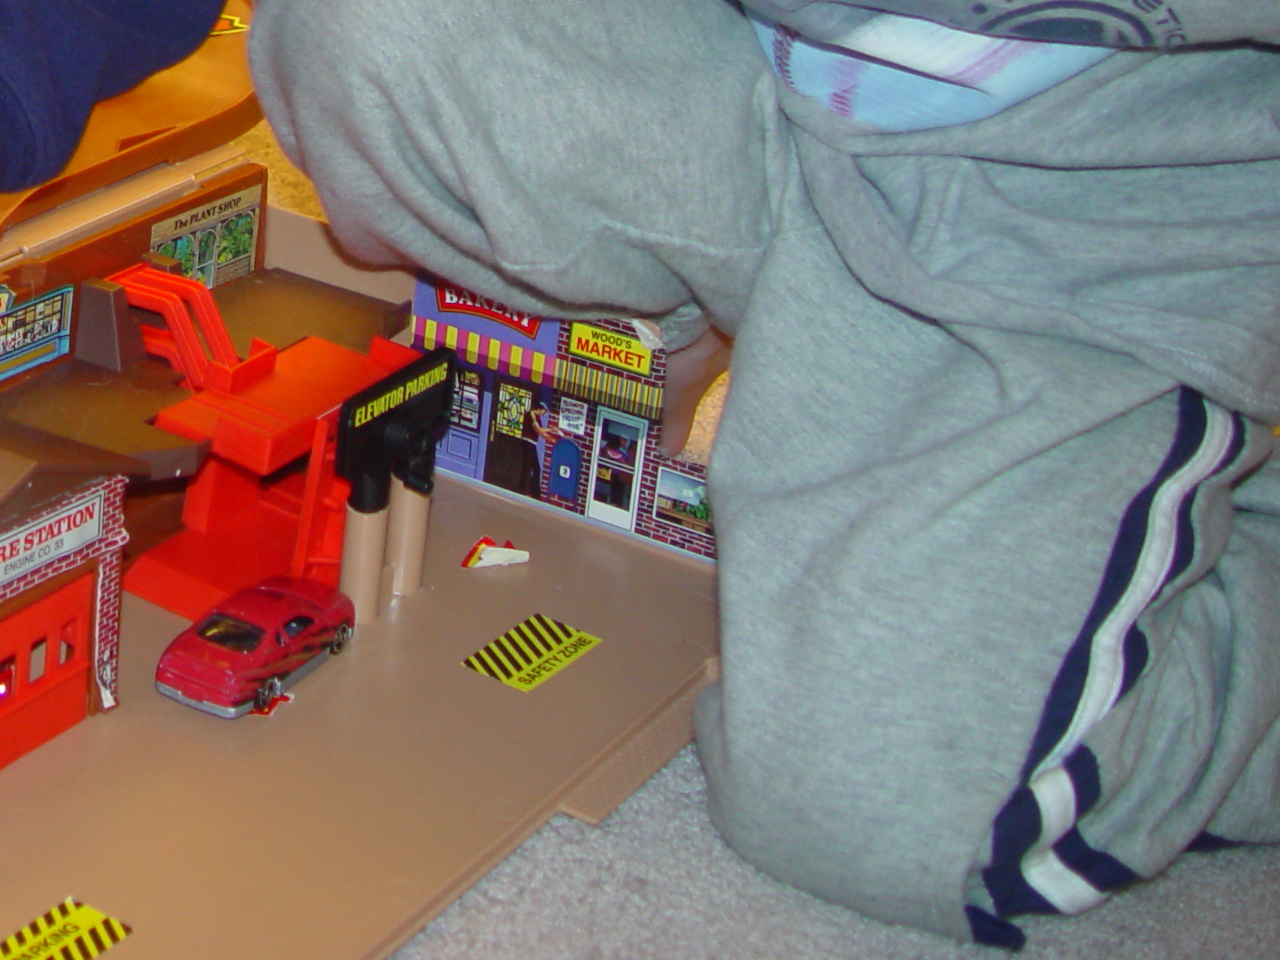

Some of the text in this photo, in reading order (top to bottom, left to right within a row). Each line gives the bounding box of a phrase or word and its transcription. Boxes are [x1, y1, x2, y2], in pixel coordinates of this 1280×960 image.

[190, 205, 219, 226] PLANT
[218, 196, 242, 215] SHOP
[444, 287, 535, 328] BAKERY
[576, 337, 645, 369] MARKET
[591, 330, 632, 349] WOOD'S
[355, 362, 448, 428] ELEVATOR PARKING
[23, 502, 97, 552] STATION
[4, 551, 36, 576] ENGINE
[518, 636, 593, 685] SAFETY ZONE
